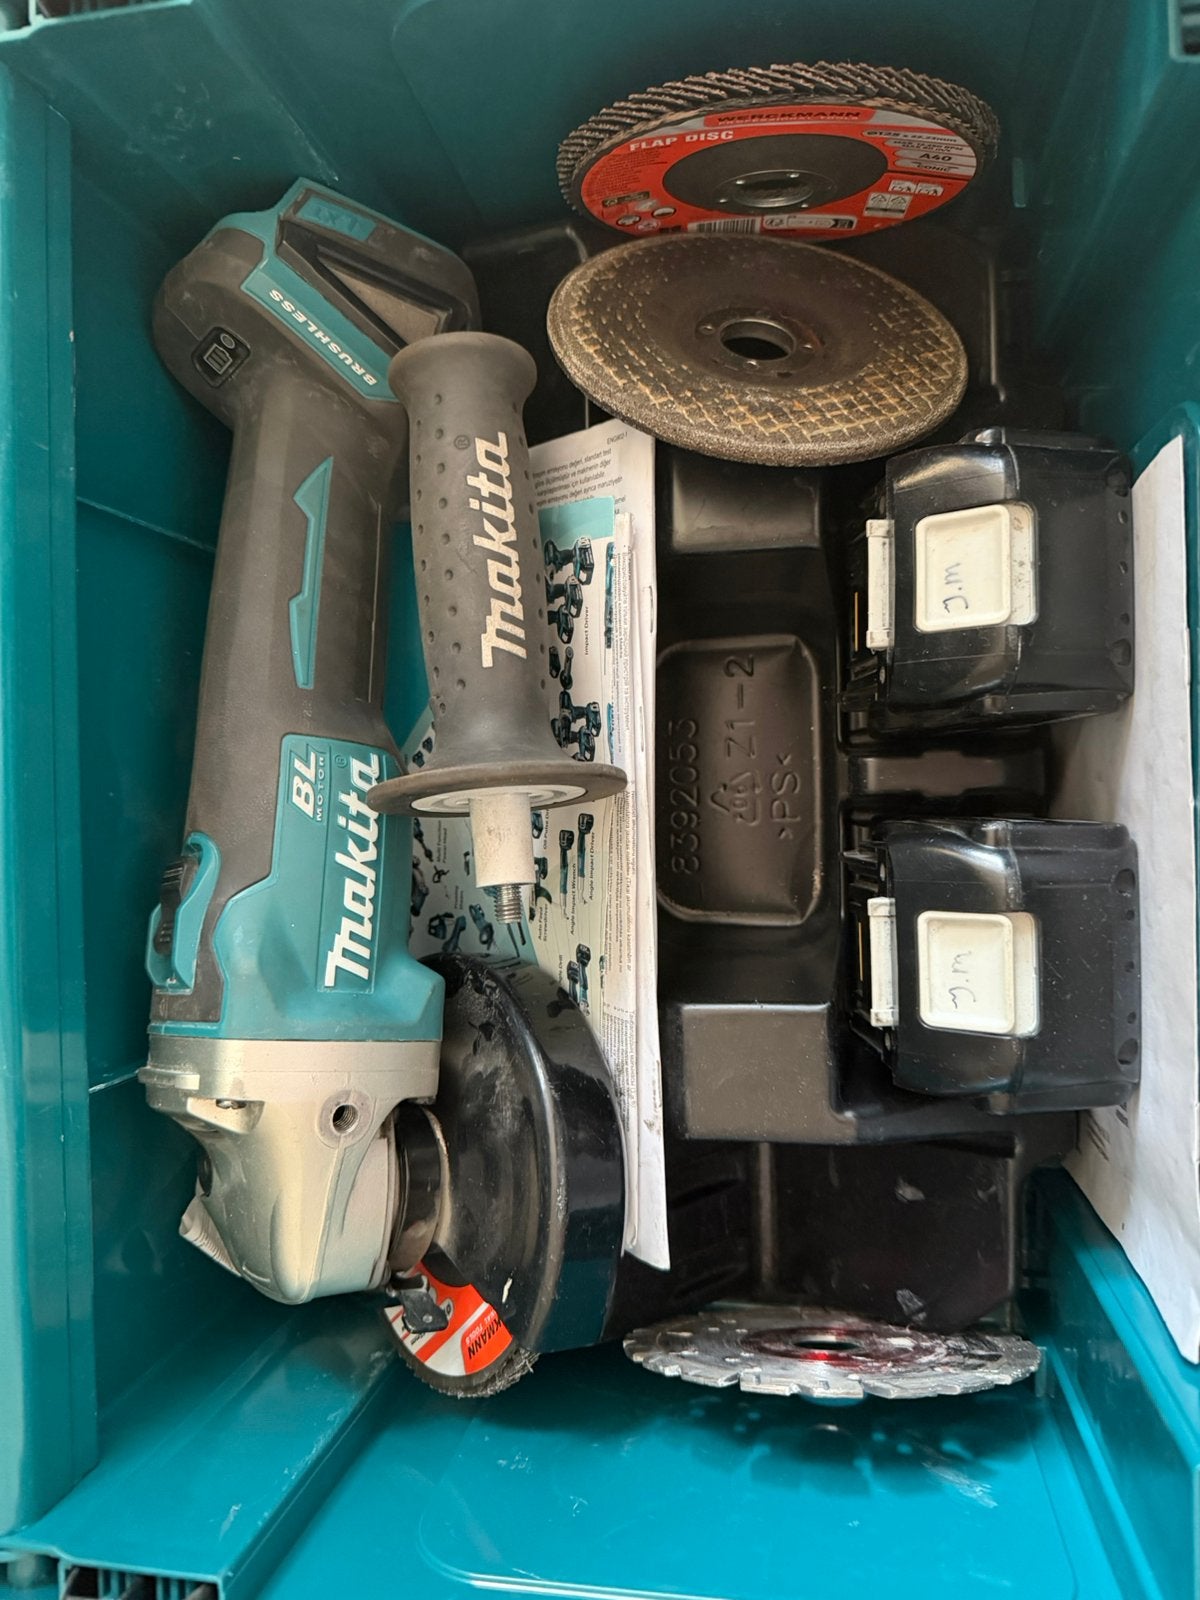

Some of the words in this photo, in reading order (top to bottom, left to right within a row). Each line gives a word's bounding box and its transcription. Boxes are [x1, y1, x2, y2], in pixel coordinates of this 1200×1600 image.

[629, 136, 678, 152] FLAP
[684, 130, 734, 144] DISC
[717, 111, 861, 122] WERCKMANN
[919, 153, 952, 162] A40
[268, 288, 378, 386] BRUSHLESS
[291, 750, 317, 819] BL
[316, 756, 326, 822] MOTOR
[669, 718, 700, 875] 8392053
[467, 1318, 502, 1360] KMANN
